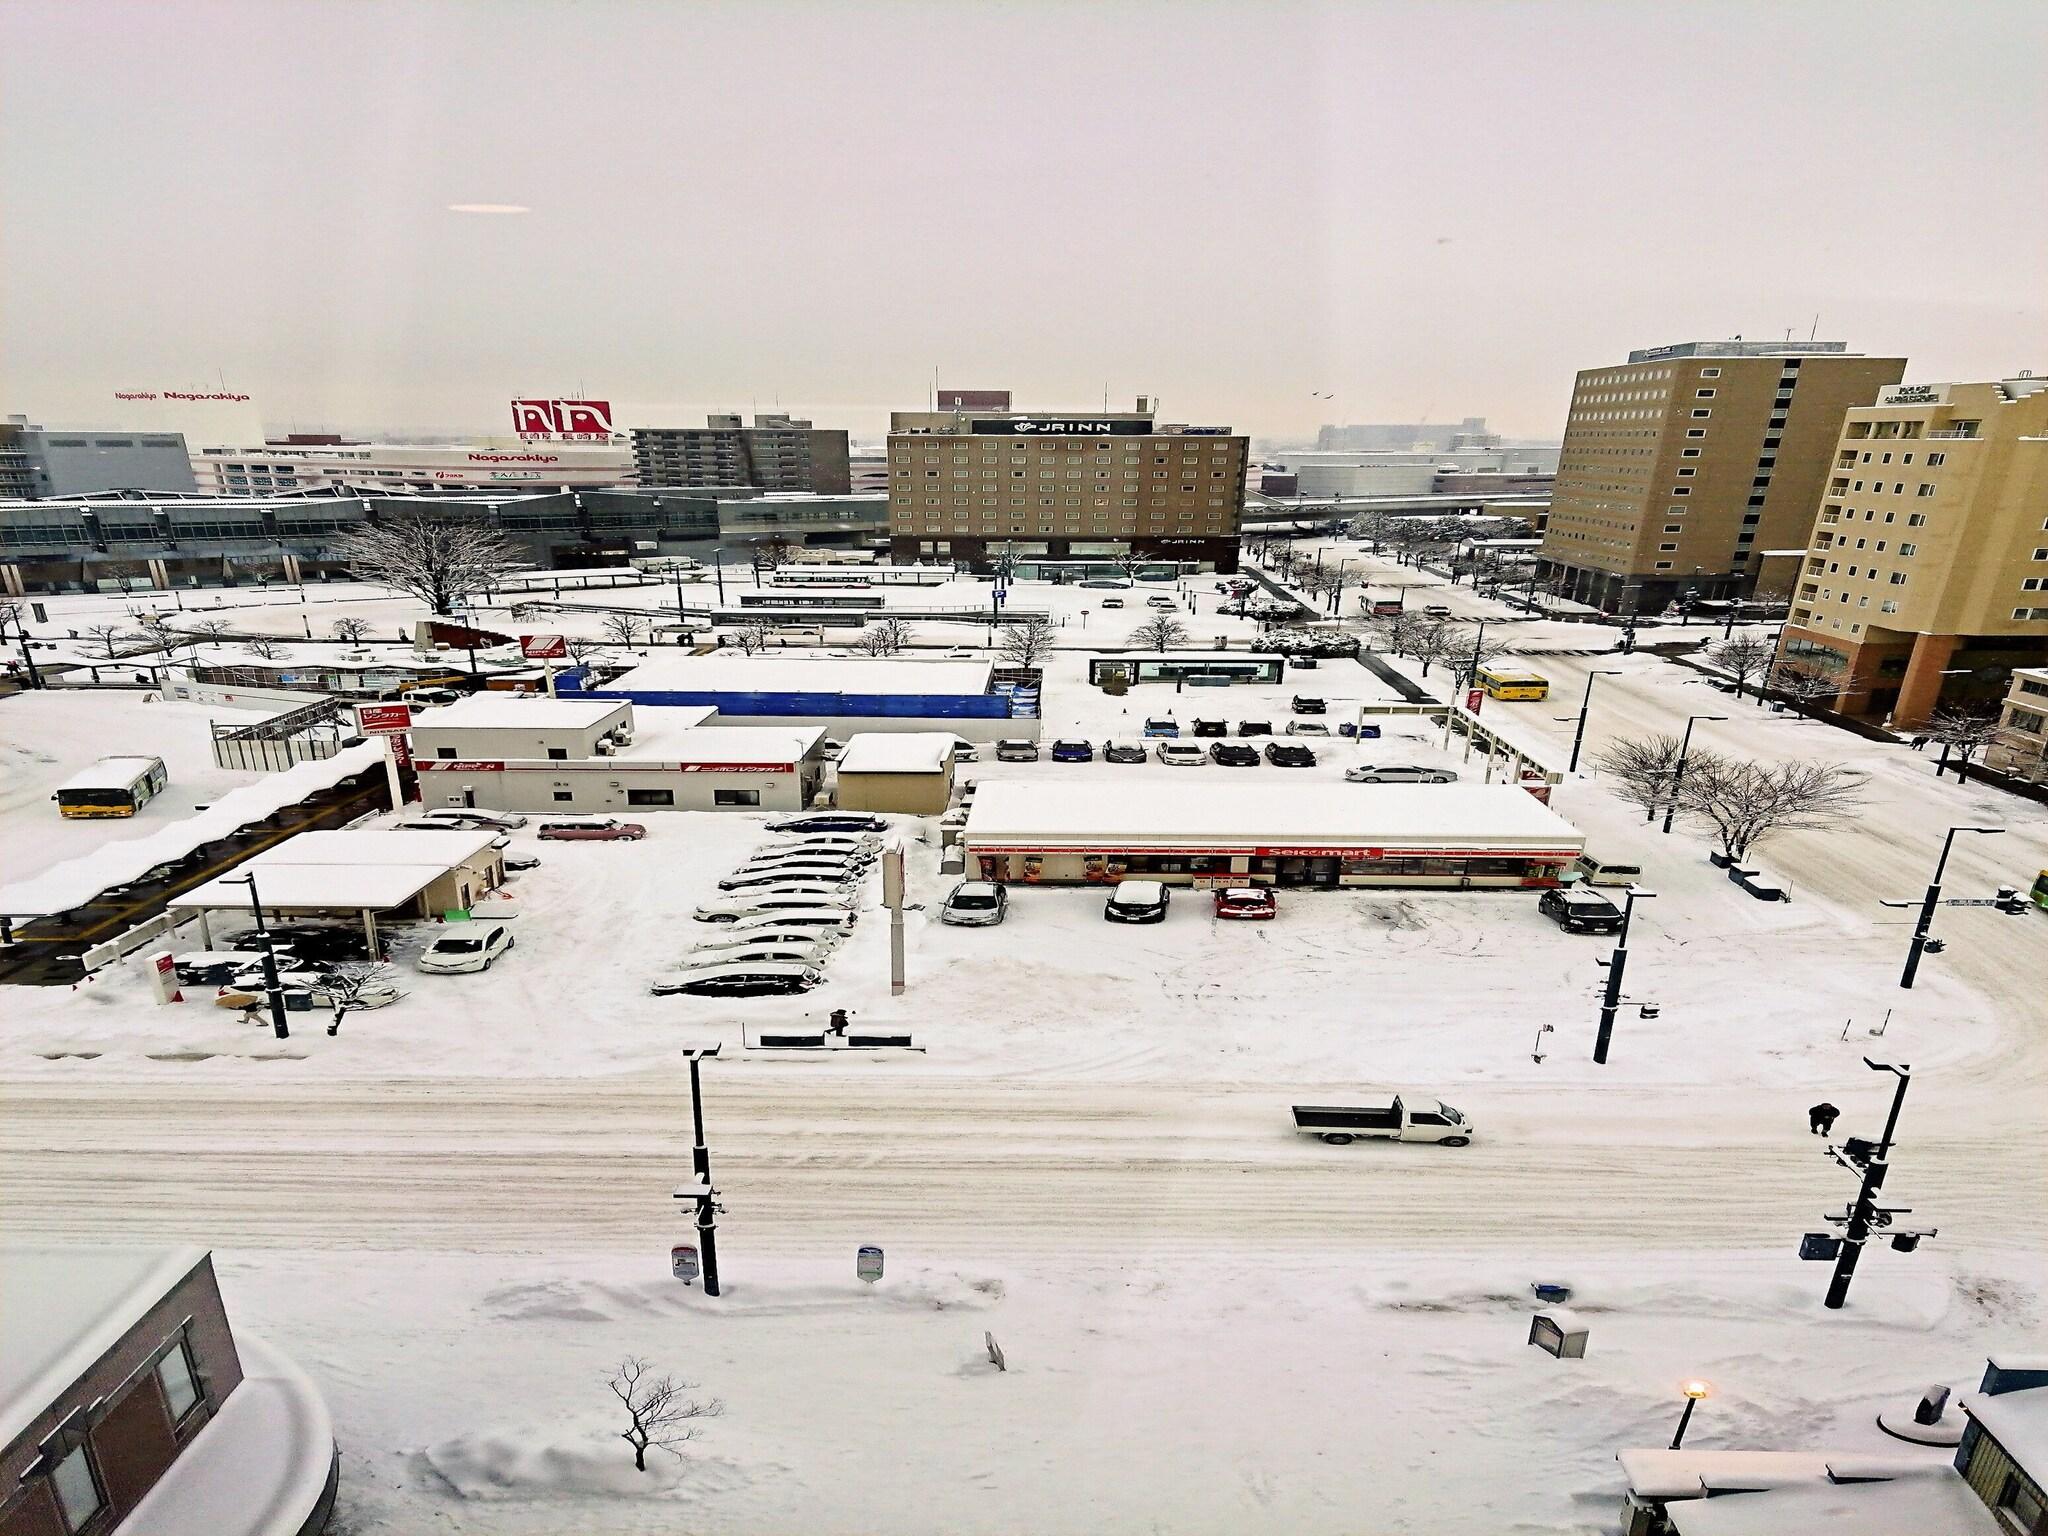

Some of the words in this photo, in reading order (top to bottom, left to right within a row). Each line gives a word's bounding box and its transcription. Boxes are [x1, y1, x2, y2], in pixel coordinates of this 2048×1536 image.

[115, 392, 157, 401] Nagasakiya
[163, 392, 250, 401] Nagasakiya
[468, 454, 558, 463] Nagasakiya
[363, 712, 406, 720] レンタカー
